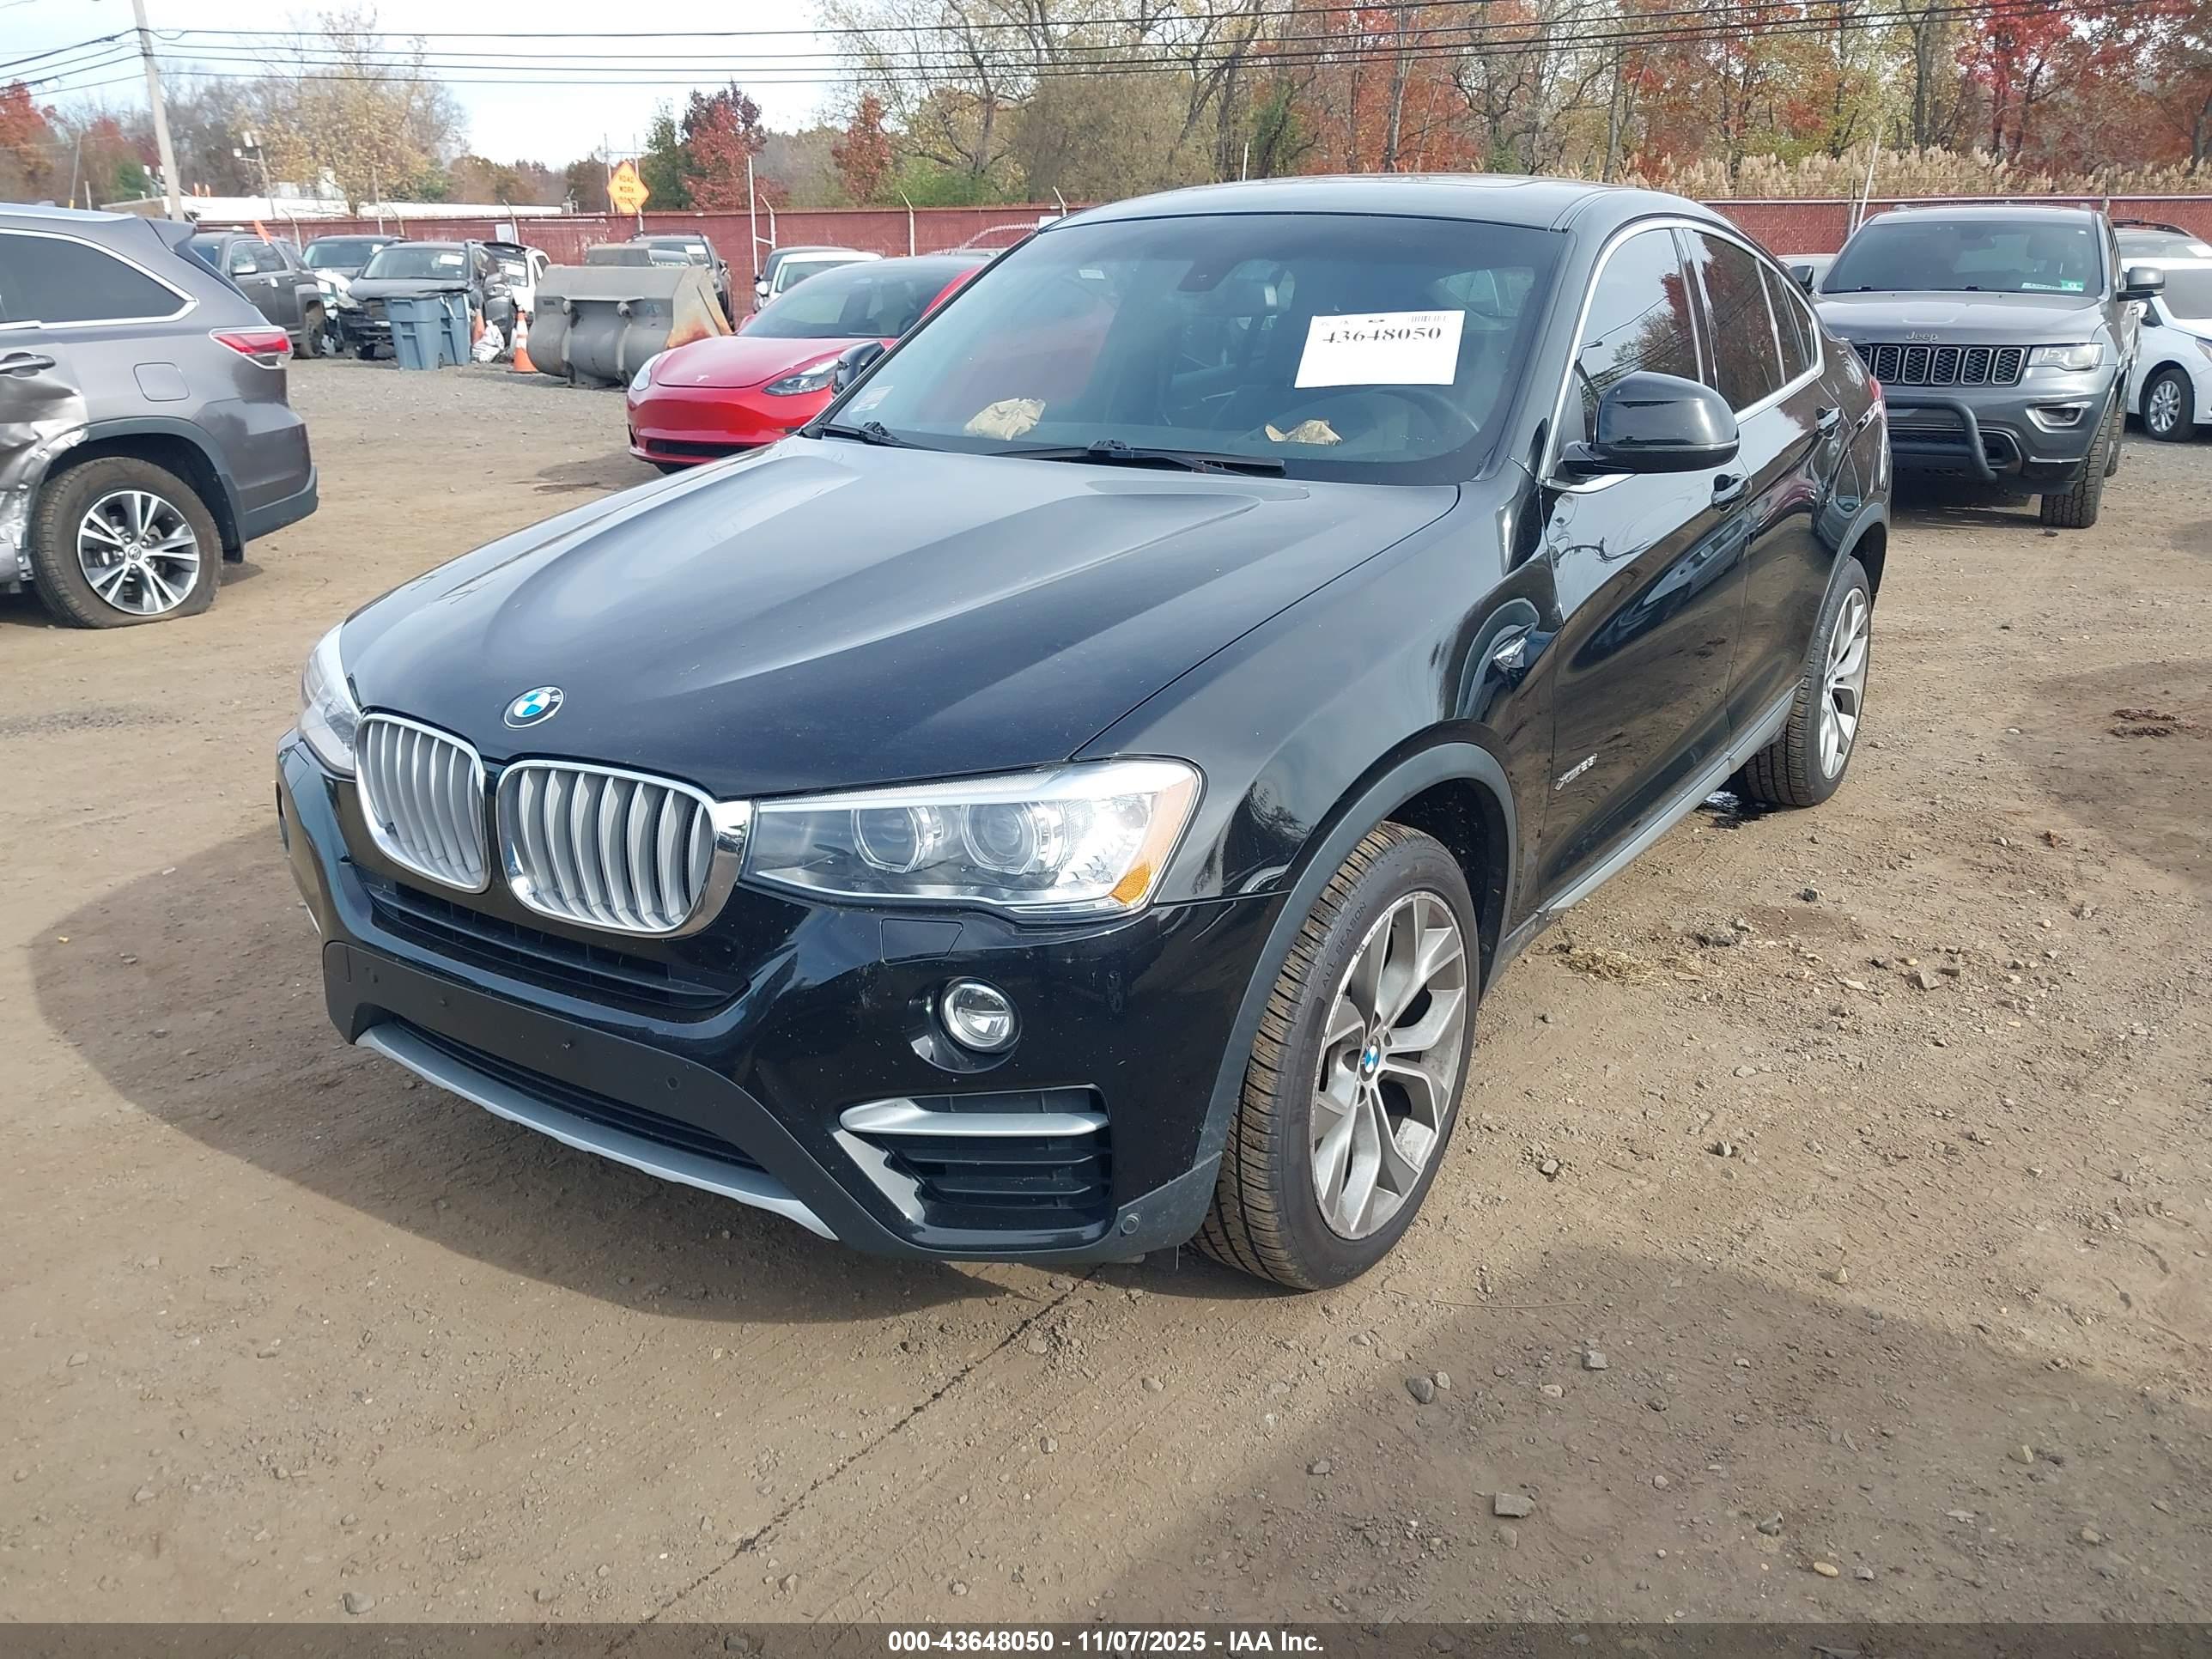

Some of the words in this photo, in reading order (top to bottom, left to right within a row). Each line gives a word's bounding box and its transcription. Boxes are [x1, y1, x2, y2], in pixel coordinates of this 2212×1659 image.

[1322, 327, 1442, 343] 43648050
[1905, 331, 1938, 343] Jeep
[1322, 961, 1337, 988] ALL
[1335, 901, 1368, 956] SEASON
